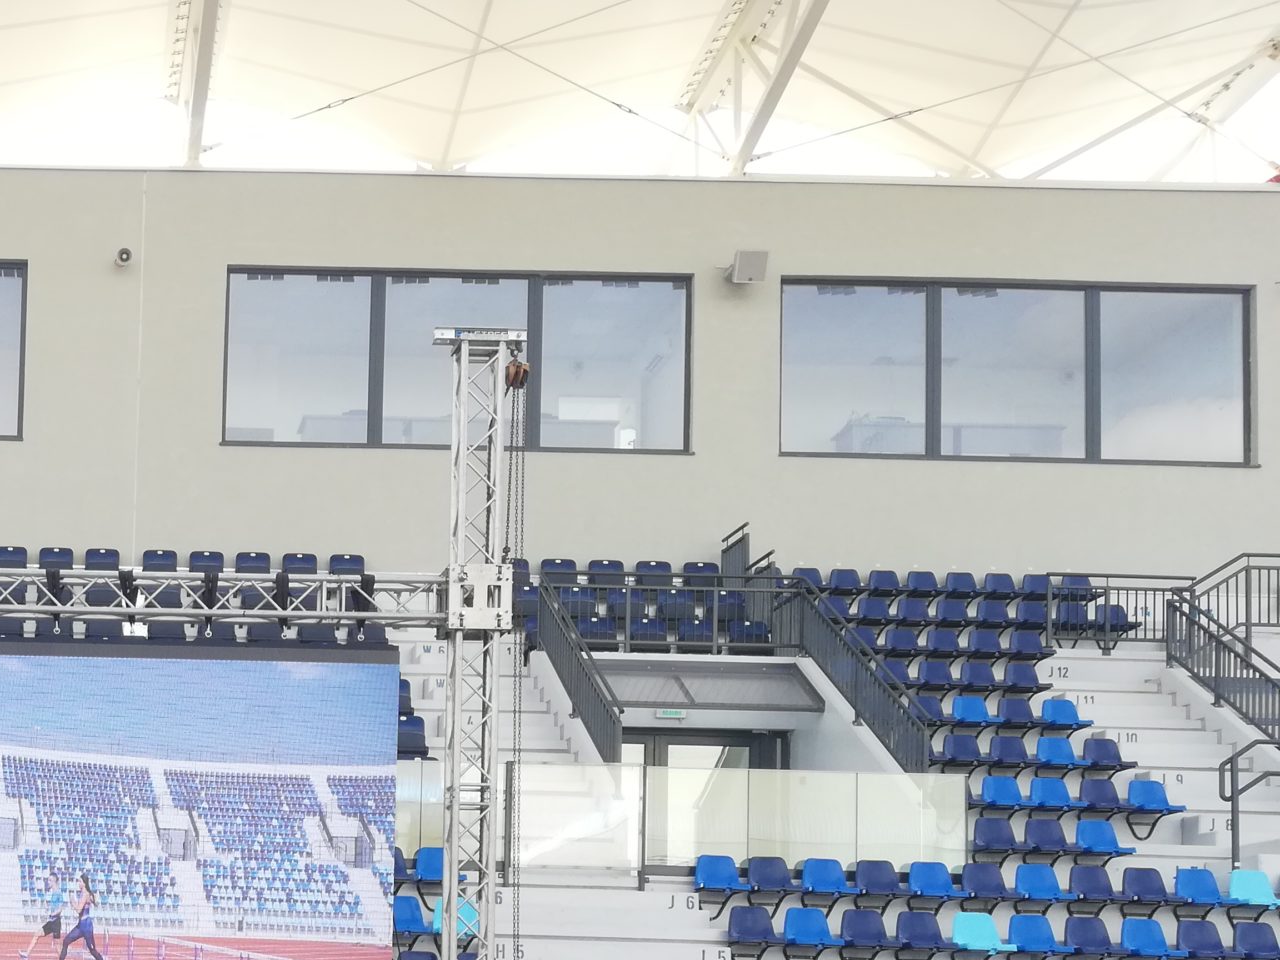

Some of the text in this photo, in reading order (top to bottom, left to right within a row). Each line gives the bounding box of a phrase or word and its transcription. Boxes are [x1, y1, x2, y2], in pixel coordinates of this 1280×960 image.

[423, 645, 432, 653] W
[1048, 666, 1069, 679] J 12
[436, 678, 445, 688] W
[1083, 695, 1095, 705] 11
[1176, 773, 1184, 785] 9
[1209, 818, 1233, 832] J 8
[667, 895, 695, 910] J 6
[495, 943, 506, 959] H
